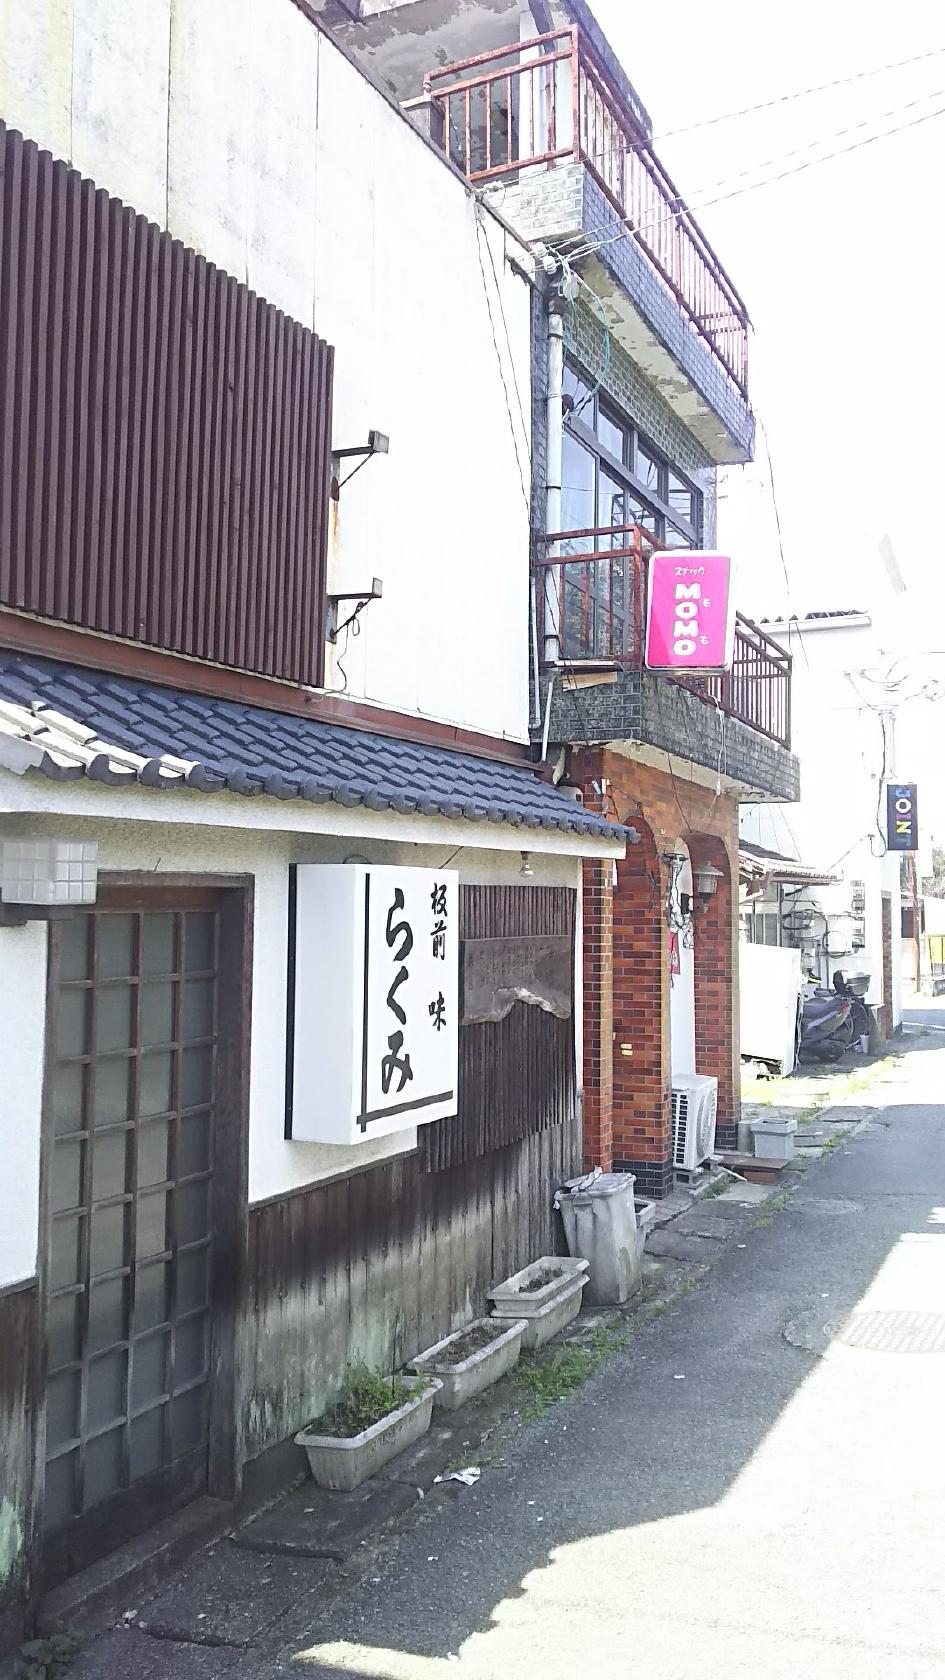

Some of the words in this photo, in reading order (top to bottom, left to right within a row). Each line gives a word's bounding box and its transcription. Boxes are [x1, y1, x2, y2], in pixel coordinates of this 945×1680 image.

[674, 566, 705, 577] スナック
[673, 583, 701, 656] MOMO
[894, 786, 912, 847] JOINT
[430, 882, 448, 961] 板前
[381, 887, 414, 1095] らくみ
[428, 991, 447, 1032] 味
